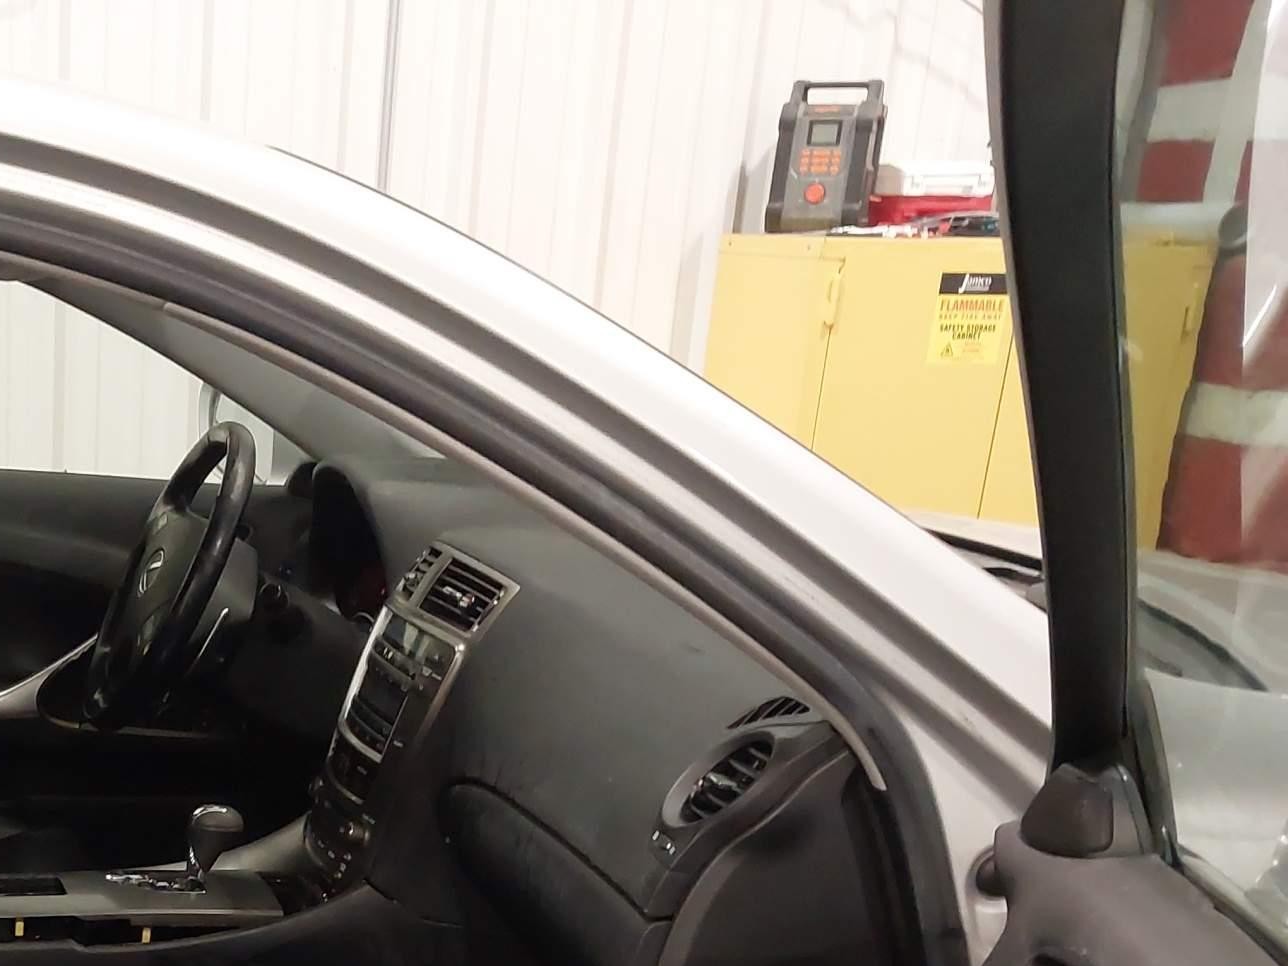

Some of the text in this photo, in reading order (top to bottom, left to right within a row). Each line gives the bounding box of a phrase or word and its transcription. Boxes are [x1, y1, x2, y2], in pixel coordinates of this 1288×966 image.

[940, 299, 1004, 312] FLAMMABLE
[940, 323, 996, 332] SAFETY STORAGE
[952, 331, 981, 340] CABINET
